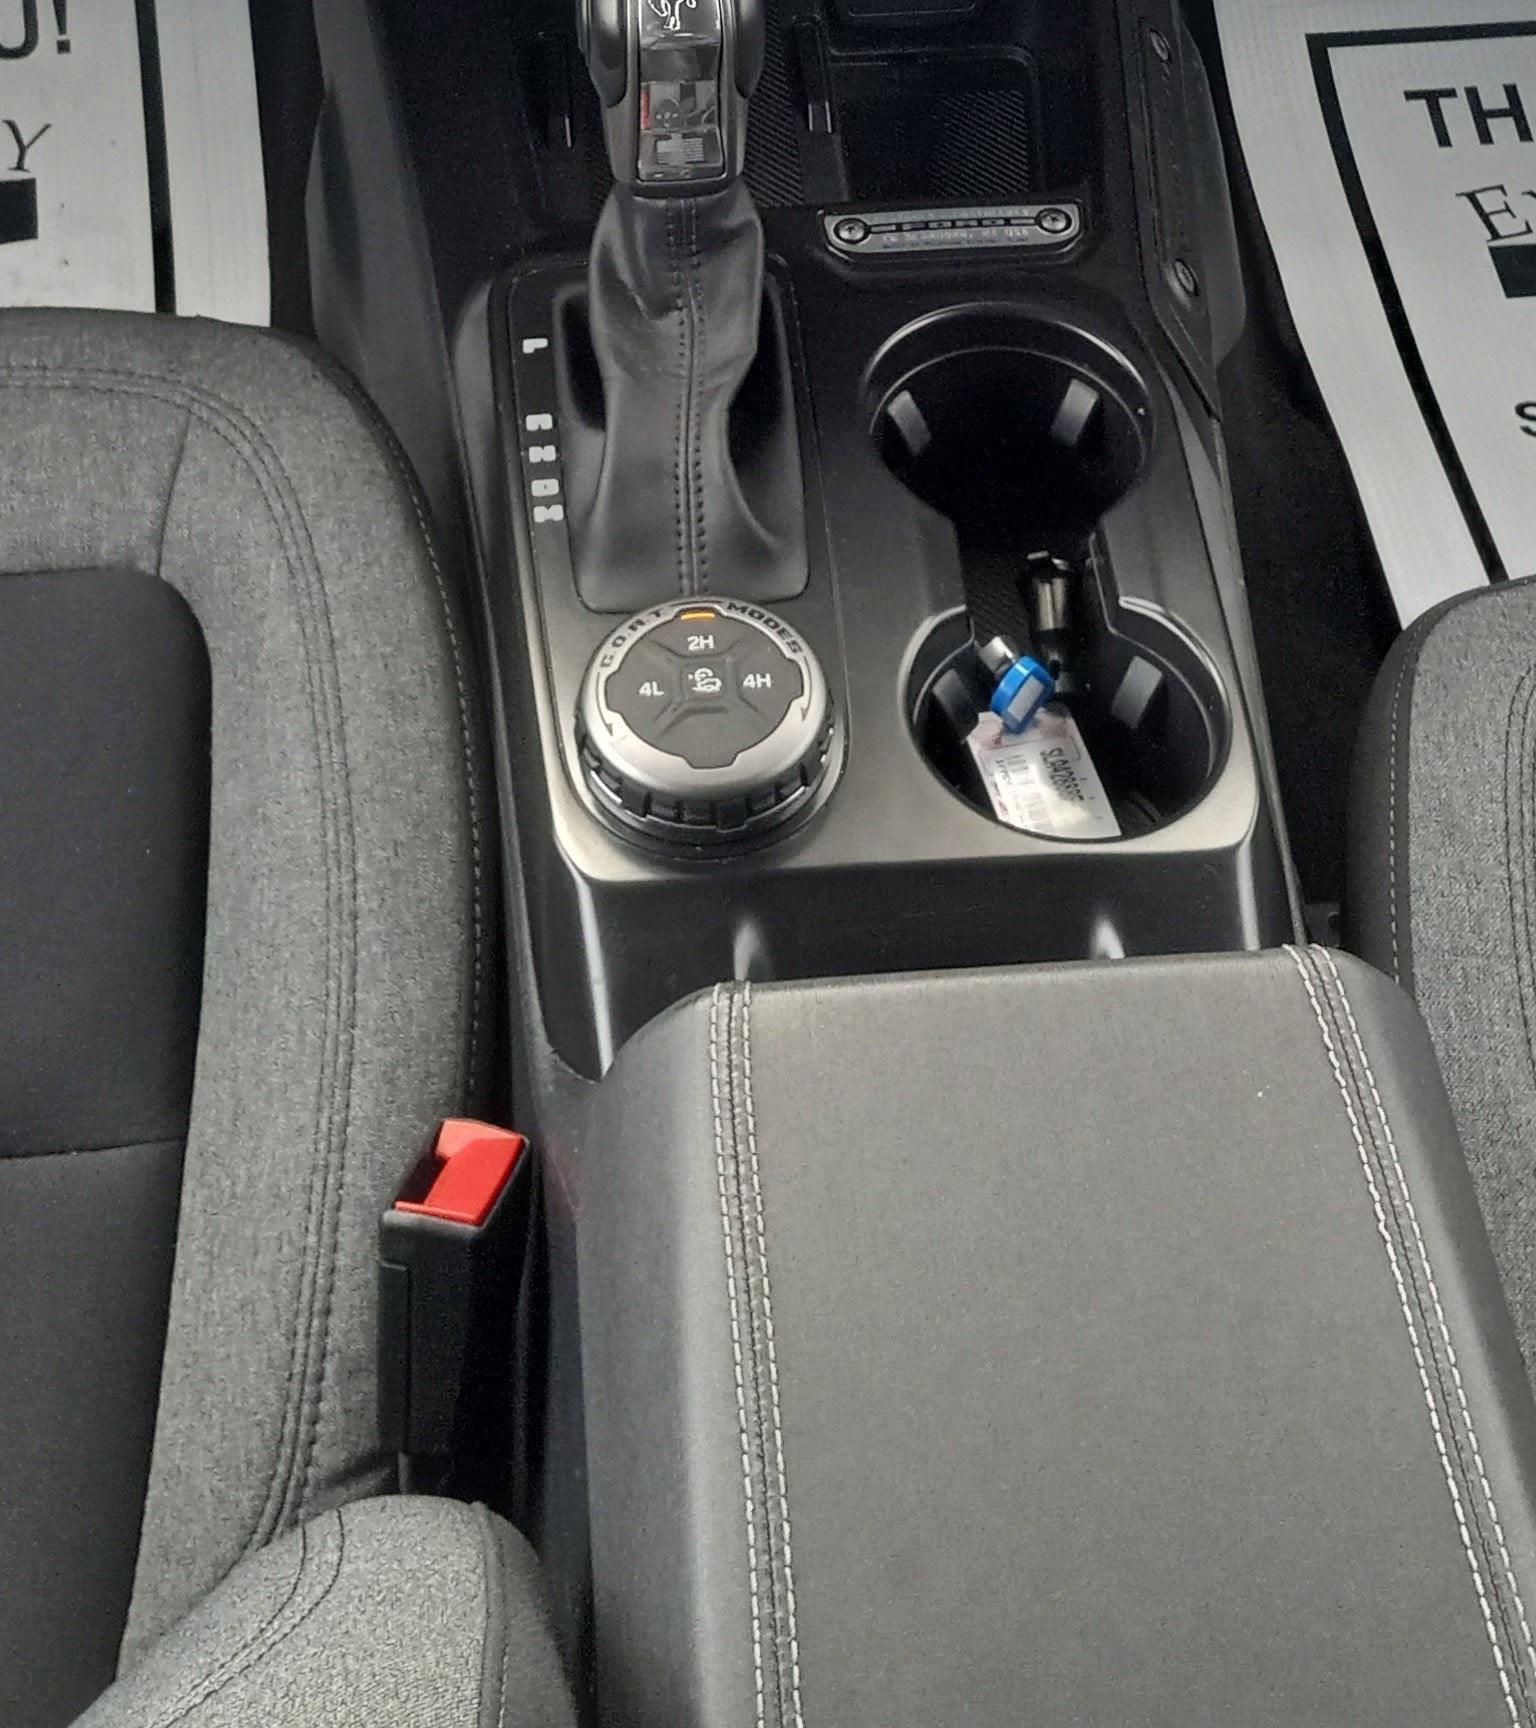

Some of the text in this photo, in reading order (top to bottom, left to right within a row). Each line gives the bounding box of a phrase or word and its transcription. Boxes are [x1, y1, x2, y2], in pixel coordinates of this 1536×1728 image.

[726, 601, 804, 655] MODES
[687, 634, 716, 652] 2H
[742, 672, 773, 689] 4H
[638, 681, 665, 698] 4L
